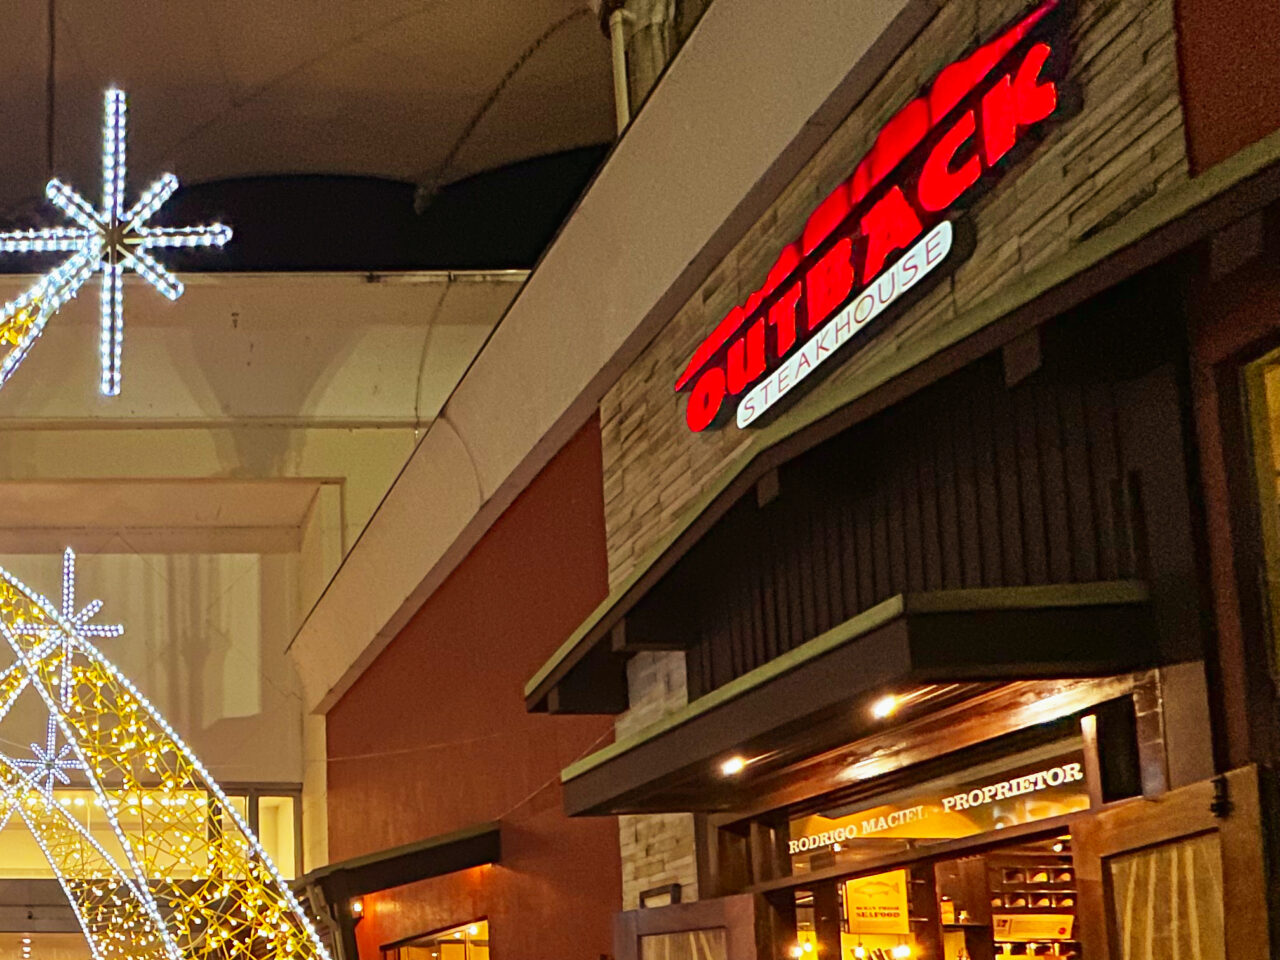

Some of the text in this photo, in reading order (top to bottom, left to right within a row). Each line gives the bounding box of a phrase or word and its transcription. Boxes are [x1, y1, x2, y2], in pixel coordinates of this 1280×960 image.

[686, 41, 1057, 433] OUTBACK
[742, 229, 944, 423] STEAKHOUSE
[788, 762, 1084, 854] RODRIGO MACIEL PROPRIETOR
[855, 911, 901, 919] SEAFOOD
